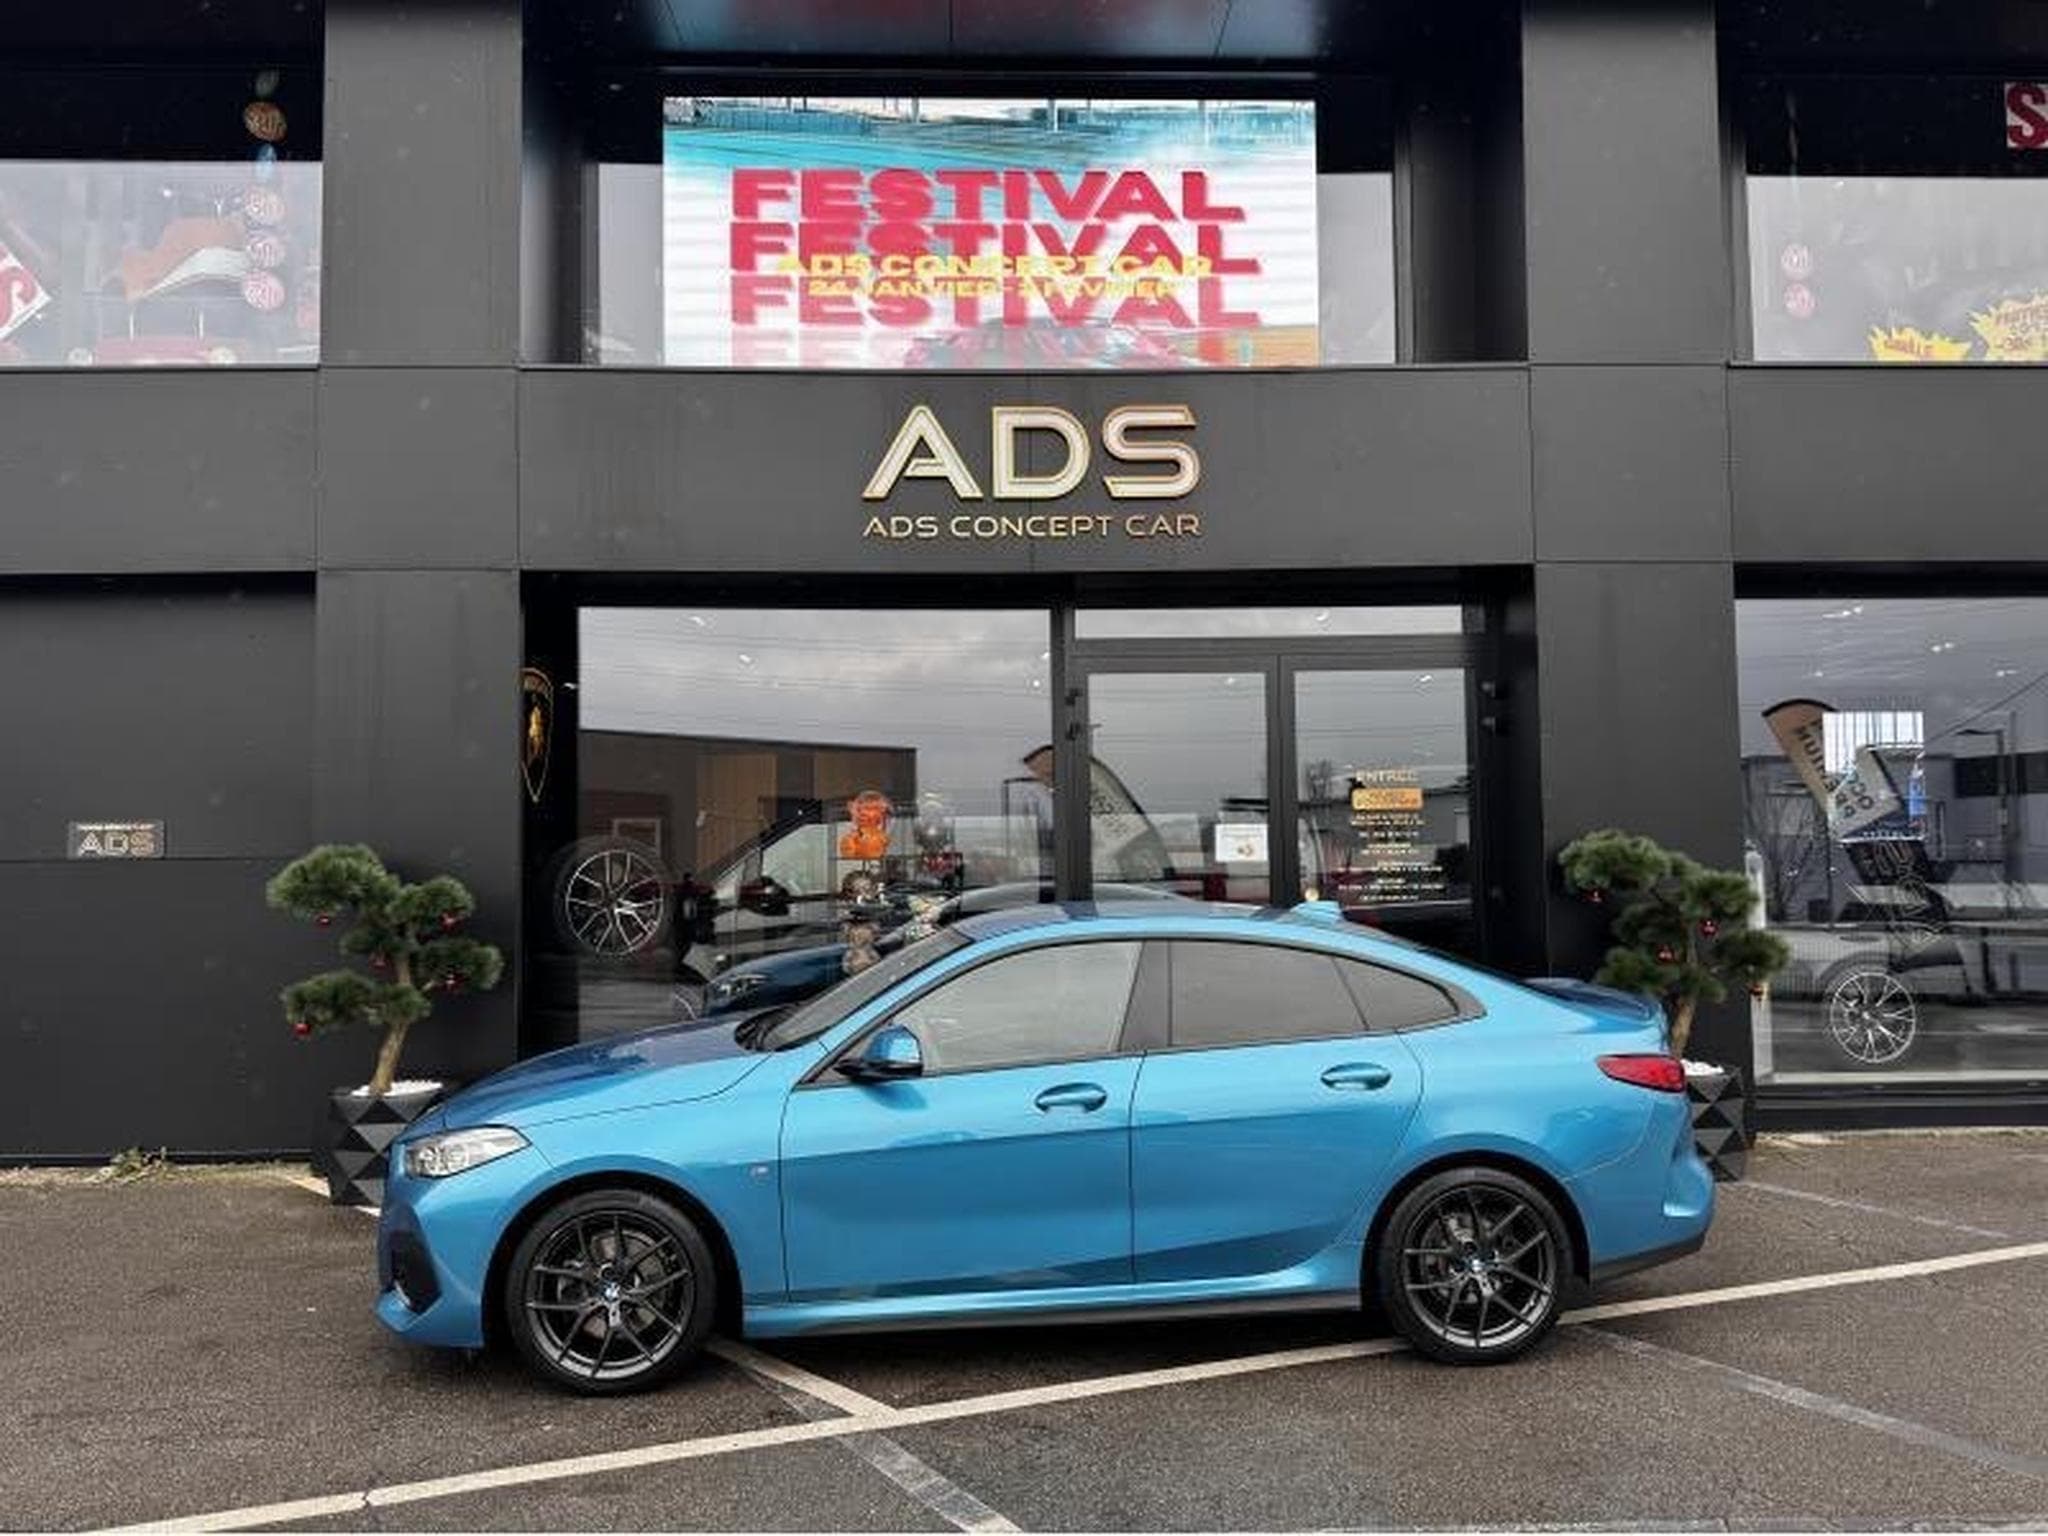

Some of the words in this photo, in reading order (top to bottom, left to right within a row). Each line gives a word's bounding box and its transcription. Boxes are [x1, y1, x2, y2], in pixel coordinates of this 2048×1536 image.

[731, 168, 1245, 222] FESTIVAL
[730, 222, 1262, 276] FESTIVAL
[778, 254, 870, 278] ADS
[879, 254, 1100, 278] CONCEPT
[1113, 255, 1213, 278] CAR
[730, 276, 1261, 327] FESTIVAL
[862, 404, 1201, 499] ADS
[863, 516, 938, 538] ADS
[951, 516, 1112, 538] CONCEPT
[1125, 515, 1201, 537] CAR
[78, 831, 155, 857] ADS
